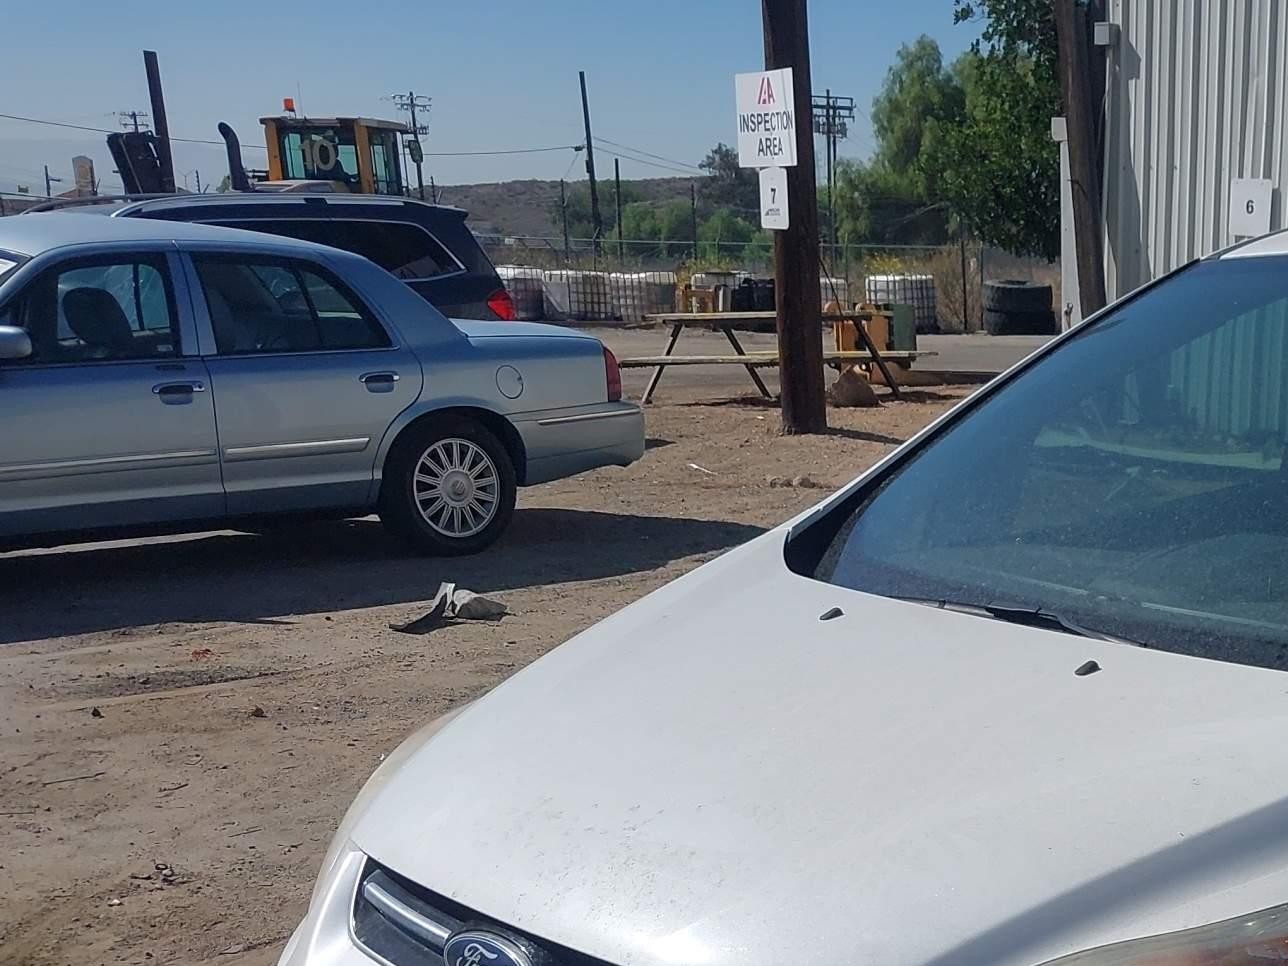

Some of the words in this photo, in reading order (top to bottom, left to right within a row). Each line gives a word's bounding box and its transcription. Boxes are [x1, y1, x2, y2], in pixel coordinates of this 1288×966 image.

[739, 110, 794, 133] INSPECTION
[300, 138, 337, 171] 10
[757, 137, 784, 157] AREA
[770, 188, 777, 204] 7
[1246, 199, 1255, 214] 6
